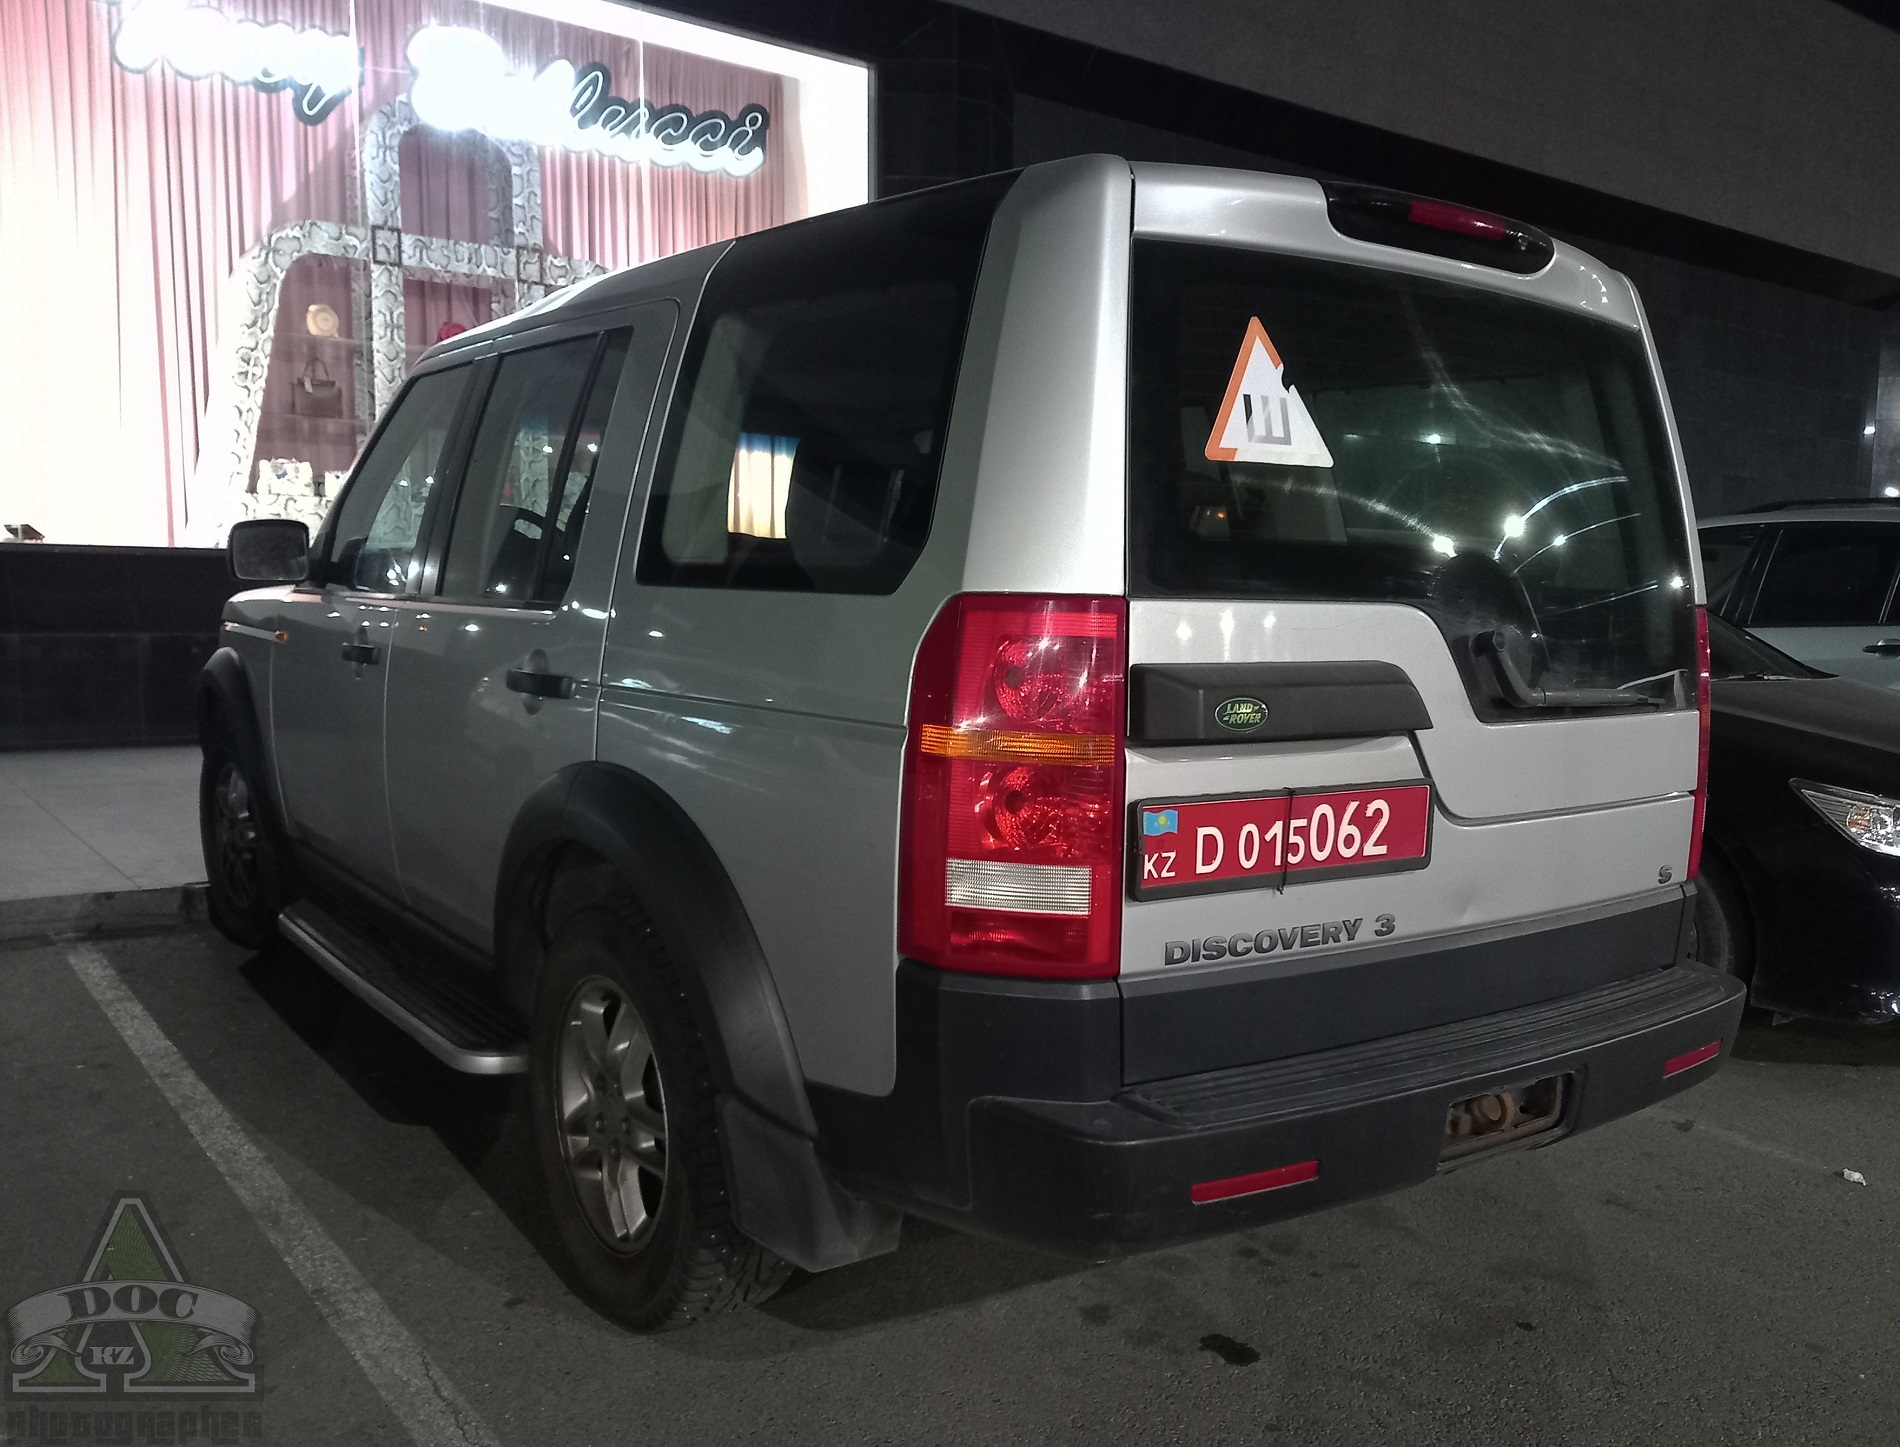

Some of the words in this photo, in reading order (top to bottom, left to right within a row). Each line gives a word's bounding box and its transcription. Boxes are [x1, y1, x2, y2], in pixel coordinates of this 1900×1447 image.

[1224, 703, 1254, 714] LAND
[1228, 712, 1262, 724] ROVER
[1195, 825, 1225, 875] D
[1237, 799, 1391, 870] 015062
[1143, 850, 1177, 880] KZ
[1657, 864, 1673, 885] S
[1164, 917, 1364, 967] DISCOVERY
[1373, 912, 1397, 938] 3
